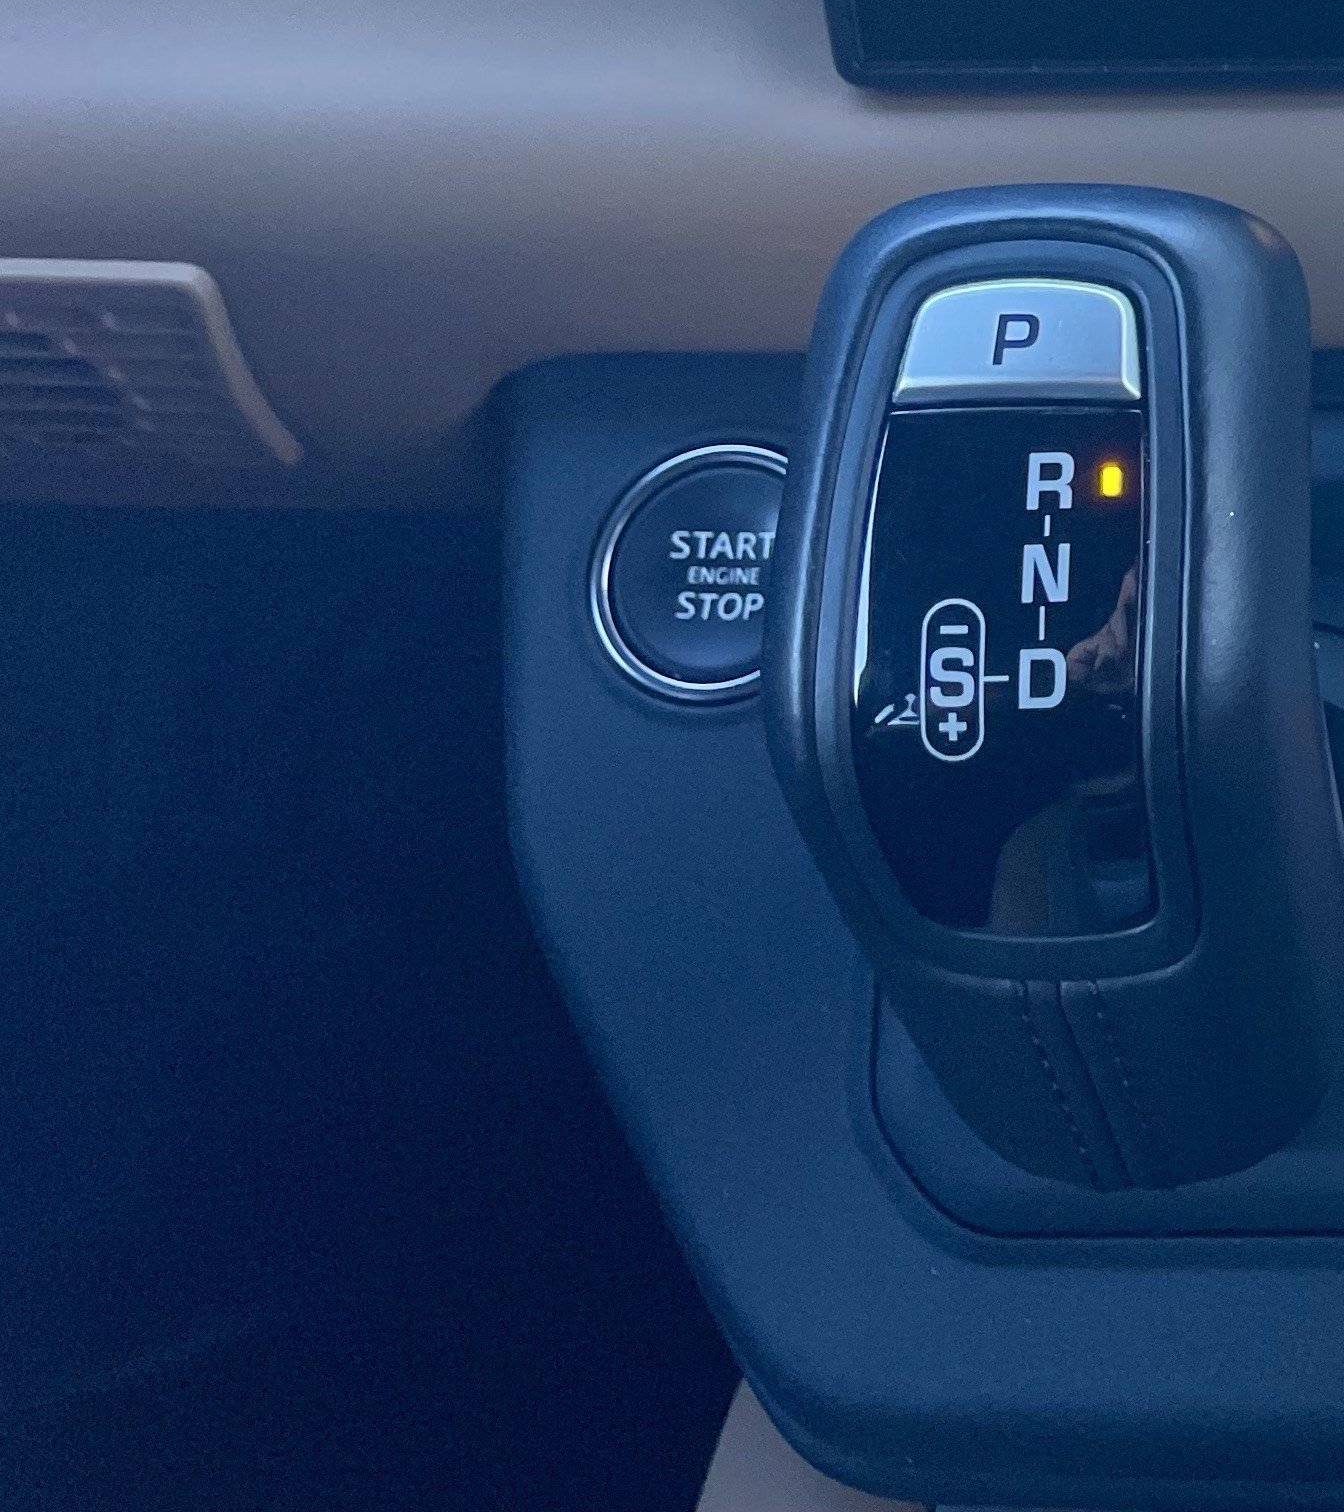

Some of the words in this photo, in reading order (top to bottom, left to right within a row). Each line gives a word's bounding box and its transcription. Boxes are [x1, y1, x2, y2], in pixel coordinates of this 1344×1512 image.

[991, 313, 1040, 366] P
[1025, 451, 1075, 511] R
[669, 530, 775, 560] START
[687, 566, 760, 585] ENGINE
[1020, 543, 1070, 604] N
[675, 592, 764, 621] STOP
[1017, 648, 1067, 709] D
